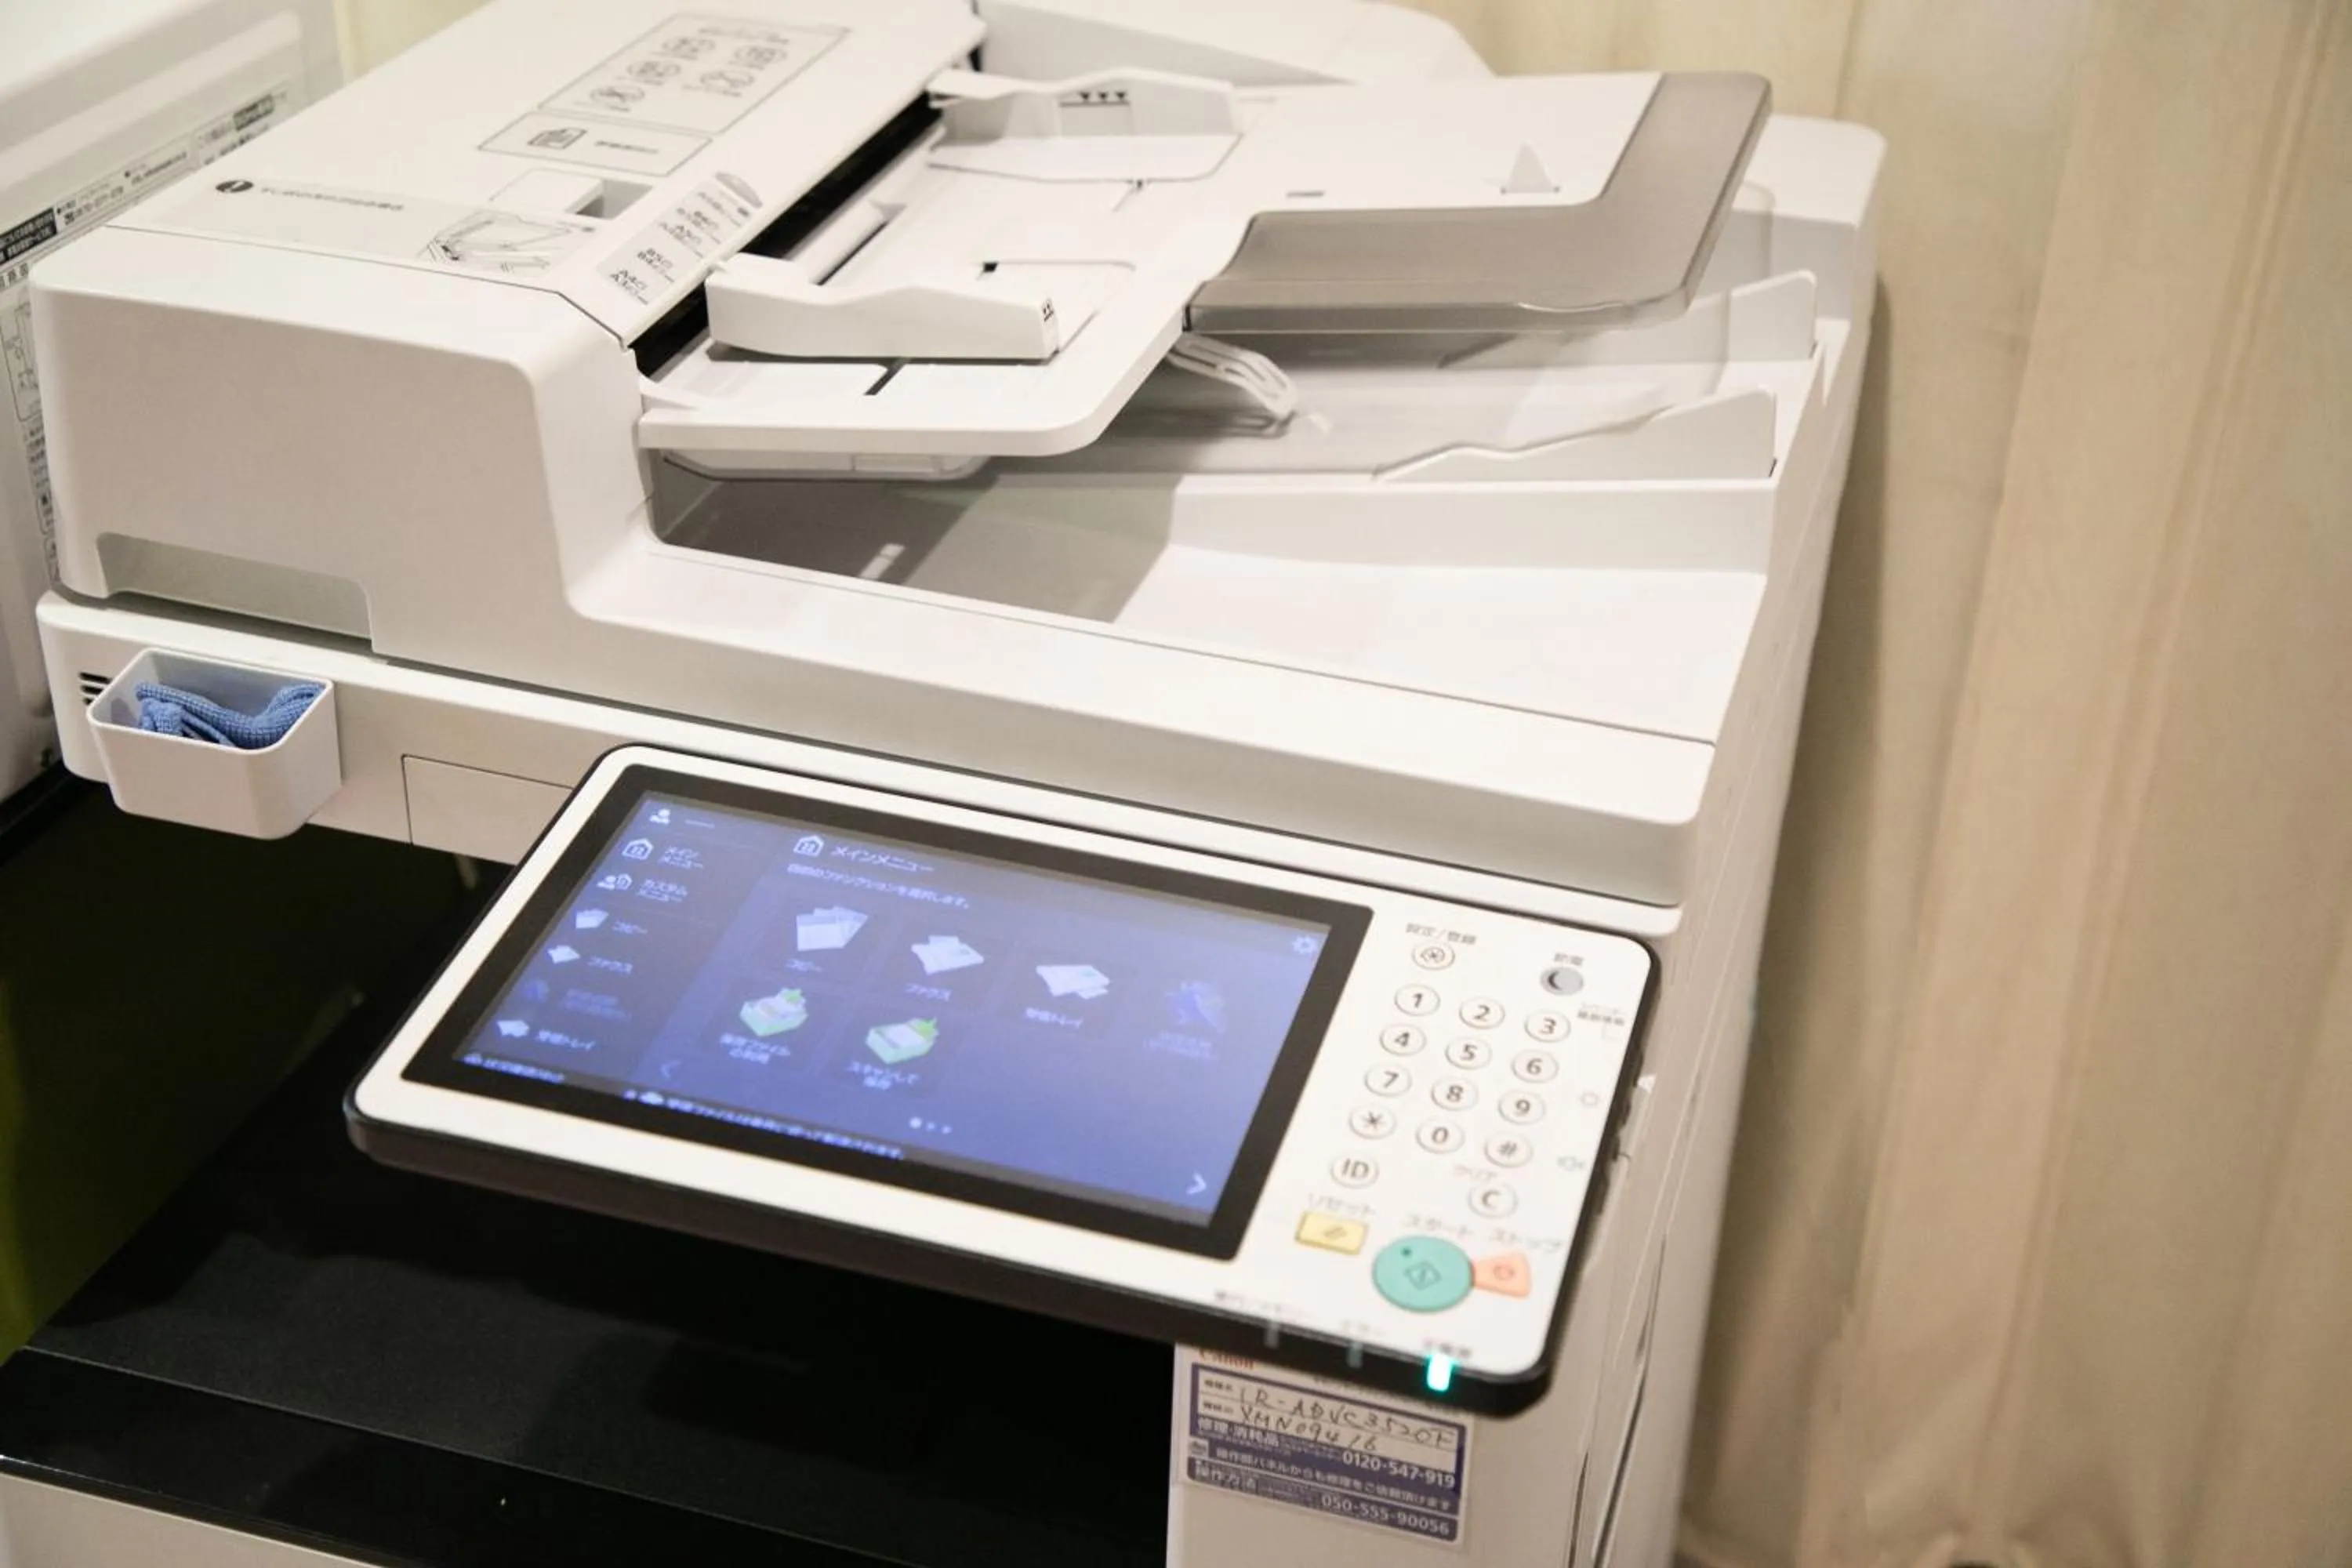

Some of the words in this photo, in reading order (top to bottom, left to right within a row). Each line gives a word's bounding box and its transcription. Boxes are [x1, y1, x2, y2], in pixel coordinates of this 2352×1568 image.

[831, 846, 935, 872] メインメニュー
